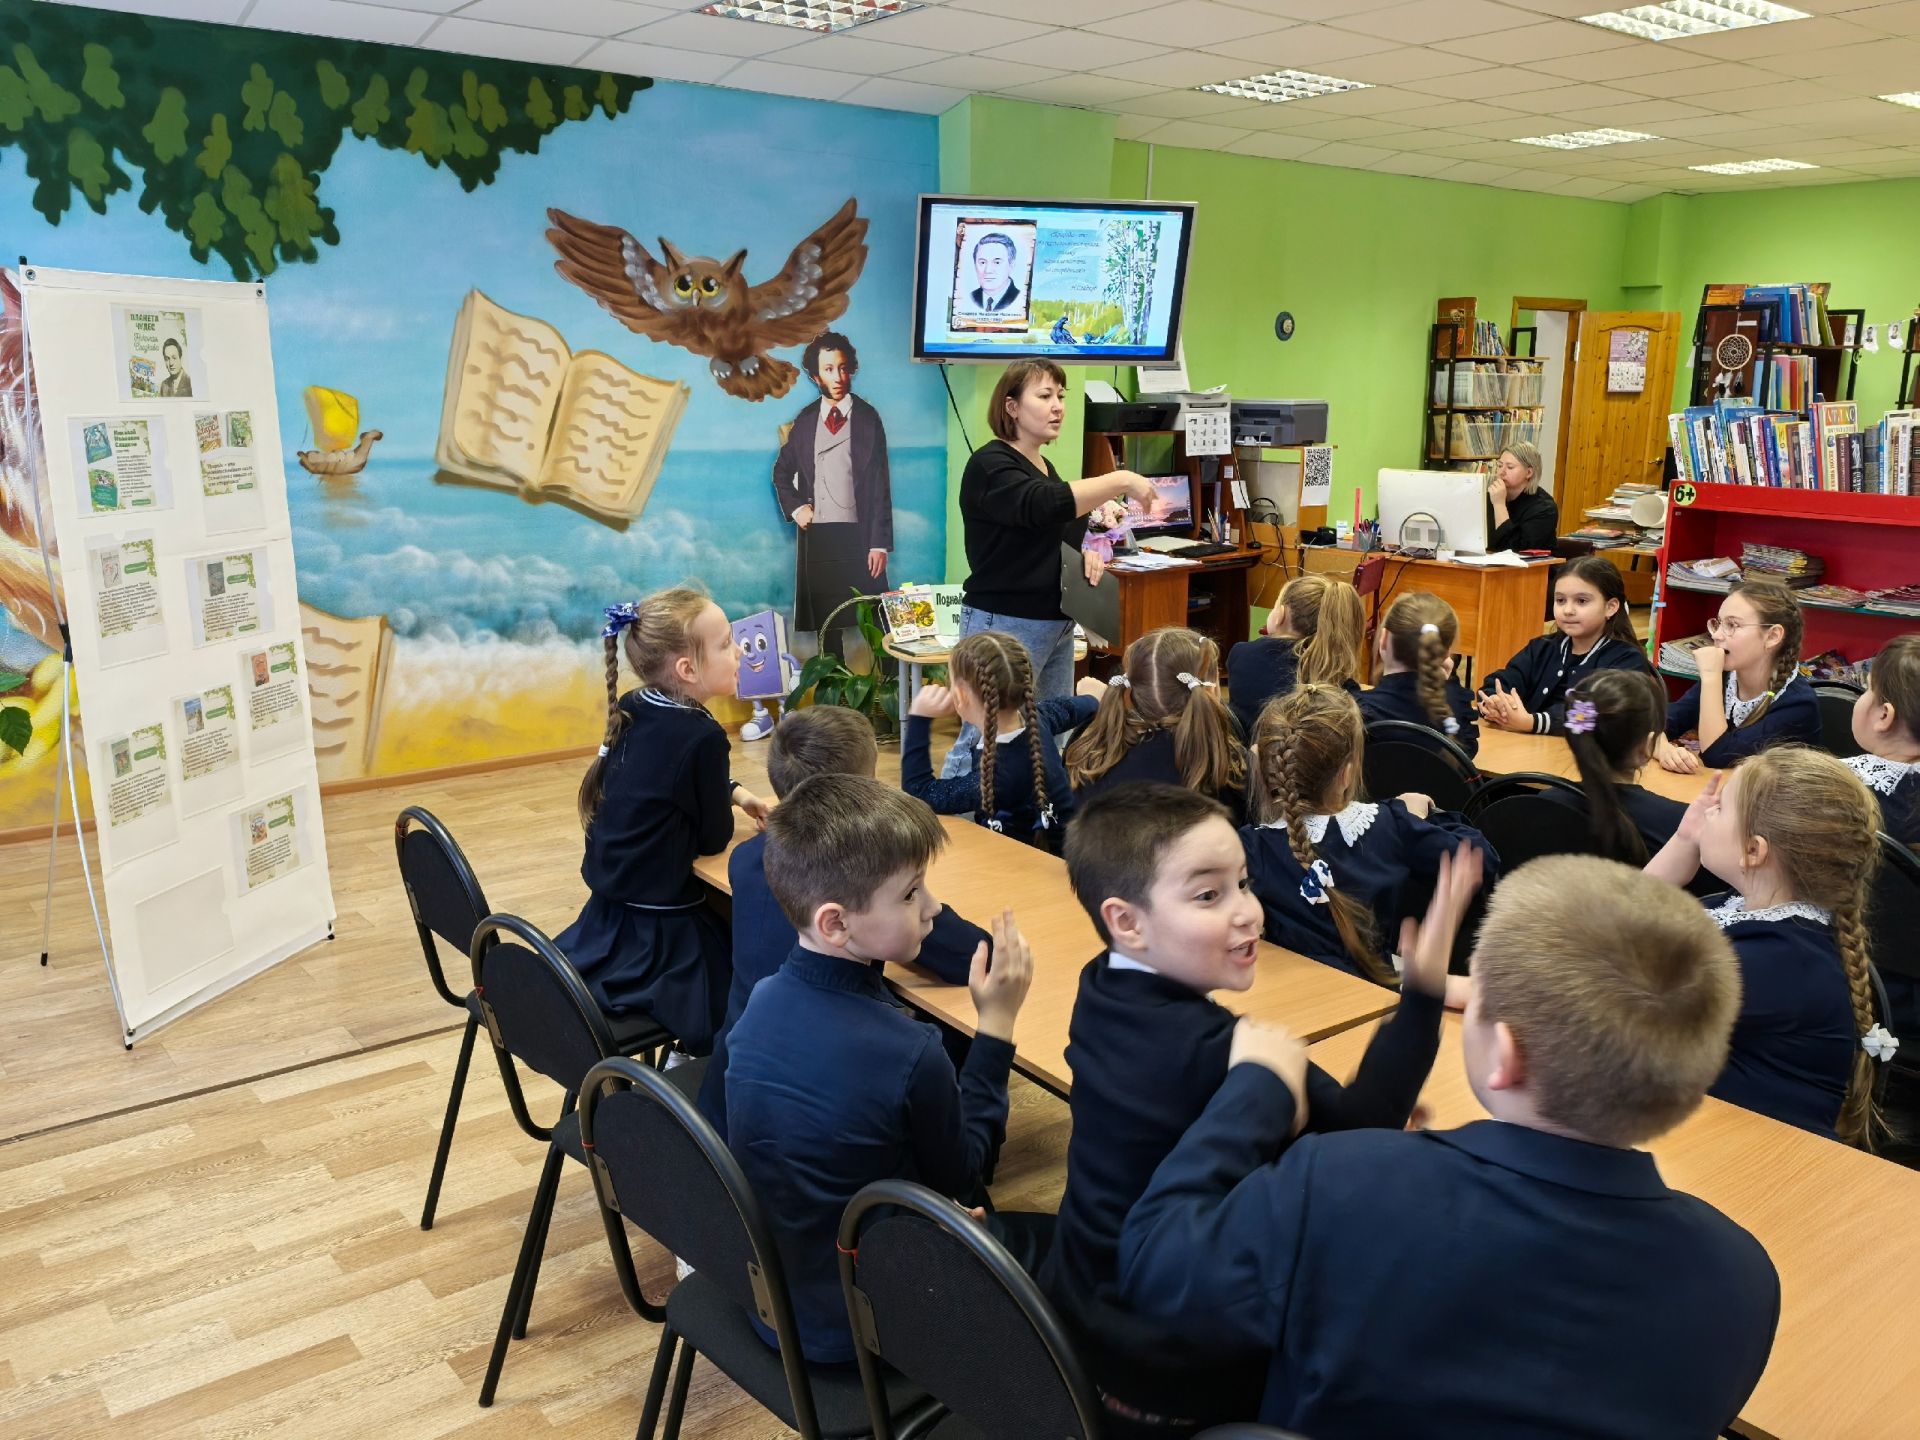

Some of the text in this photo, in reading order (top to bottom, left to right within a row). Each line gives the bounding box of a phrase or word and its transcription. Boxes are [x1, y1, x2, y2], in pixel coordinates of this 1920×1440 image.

[130, 313, 159, 322] ПЛАНЕТА
[135, 322, 156, 331] ЧУДЕС
[1675, 485, 1695, 502] 6+
[952, 613, 961, 626] пр
